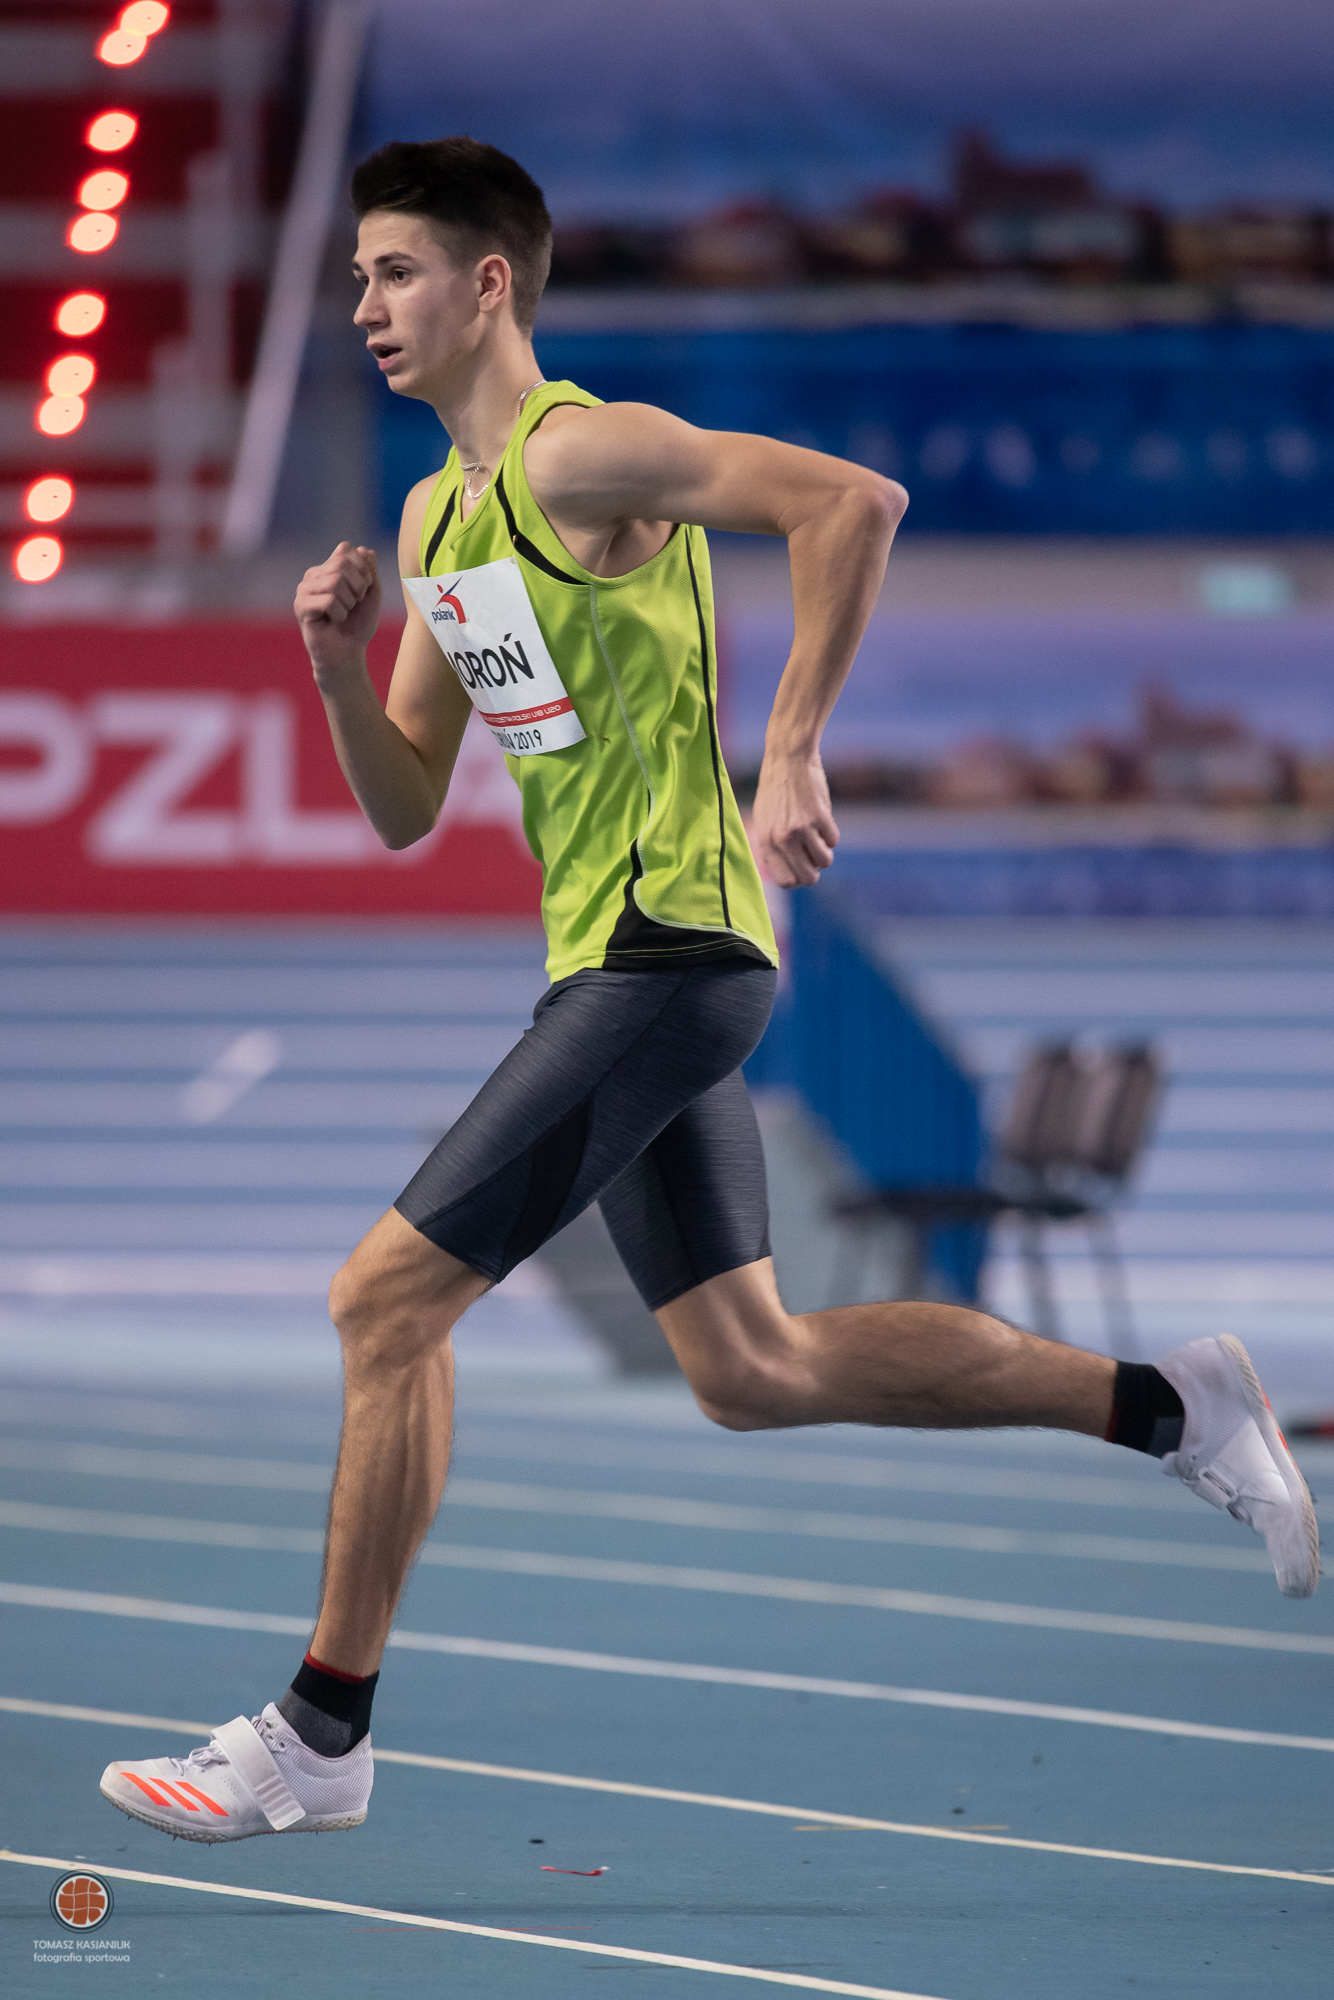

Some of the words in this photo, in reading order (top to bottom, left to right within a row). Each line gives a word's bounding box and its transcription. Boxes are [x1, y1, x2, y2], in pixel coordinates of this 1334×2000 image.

[532, 709, 544, 718] U18
[544, 704, 561, 714] U20
[514, 729, 543, 750] 2019
